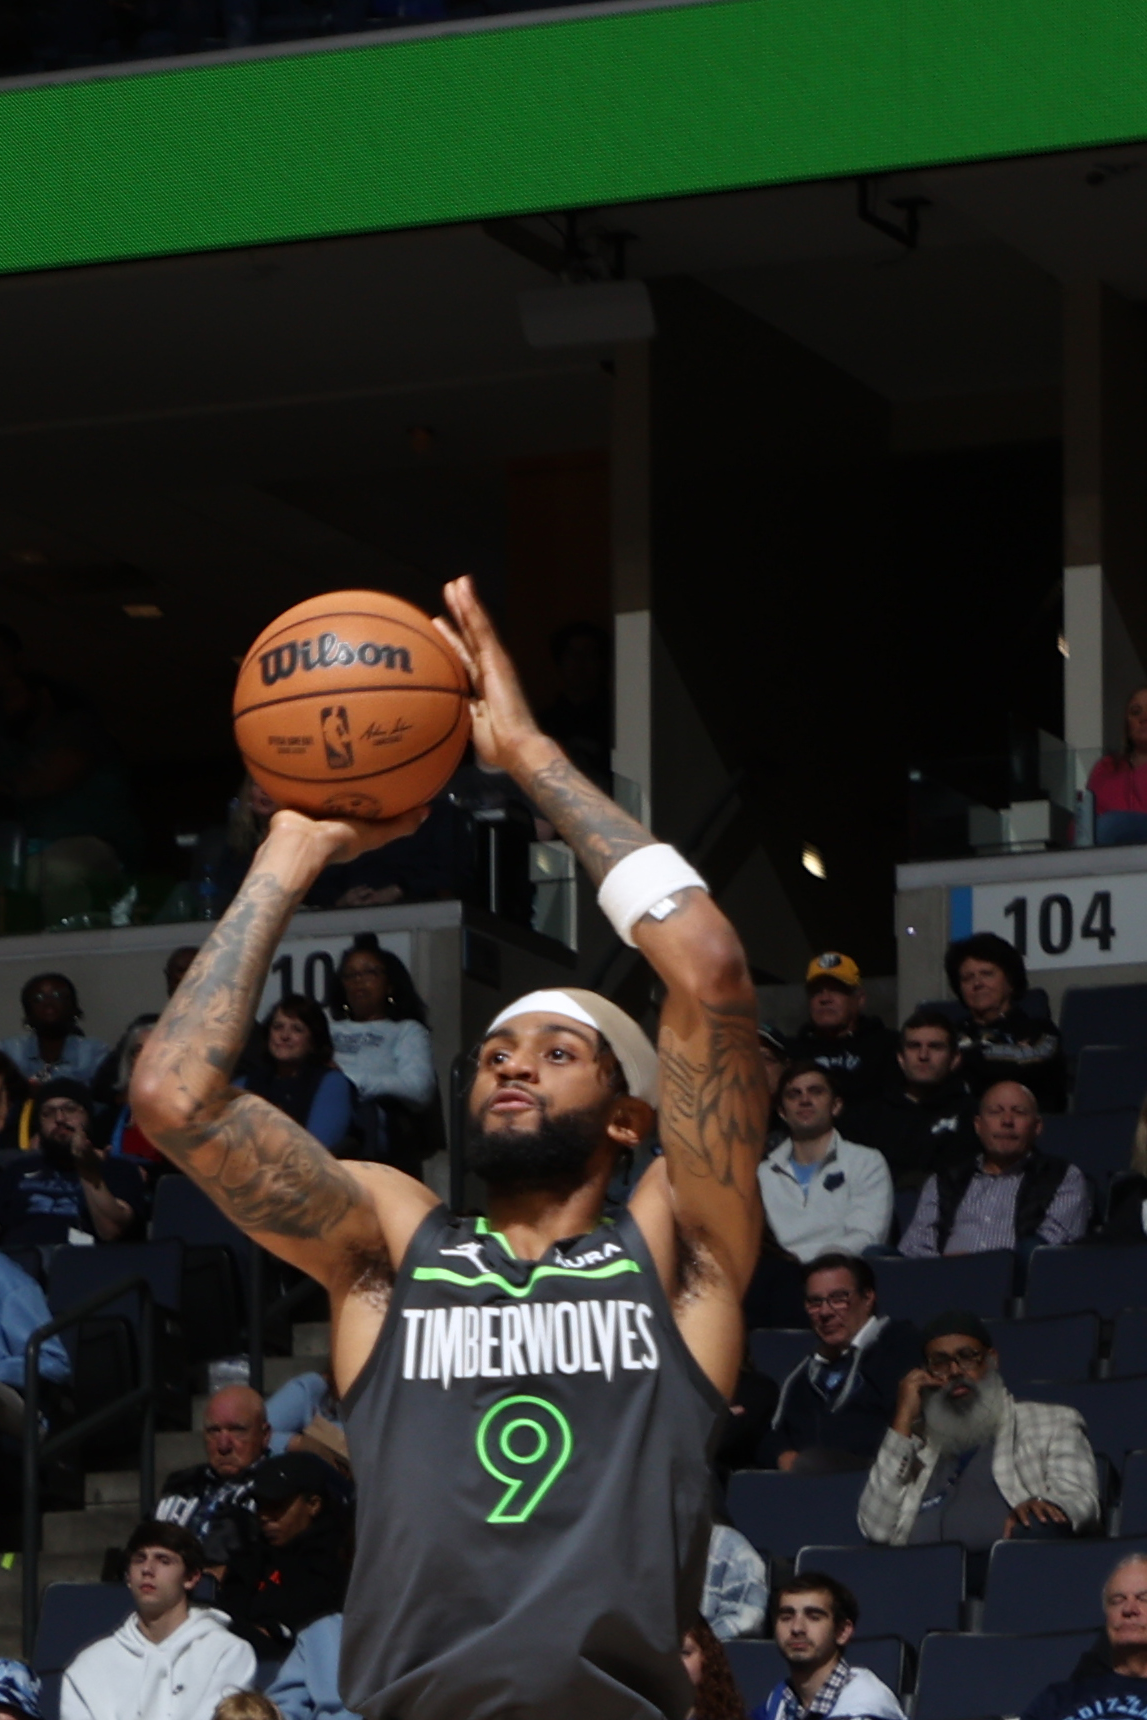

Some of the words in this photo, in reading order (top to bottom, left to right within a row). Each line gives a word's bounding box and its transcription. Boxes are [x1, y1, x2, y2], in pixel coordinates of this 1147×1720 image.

[259, 632, 414, 687] Wilson
[1003, 890, 1116, 957] 104
[402, 1298, 660, 1391] TIMBERWOLVES
[474, 1394, 573, 1524] 9
